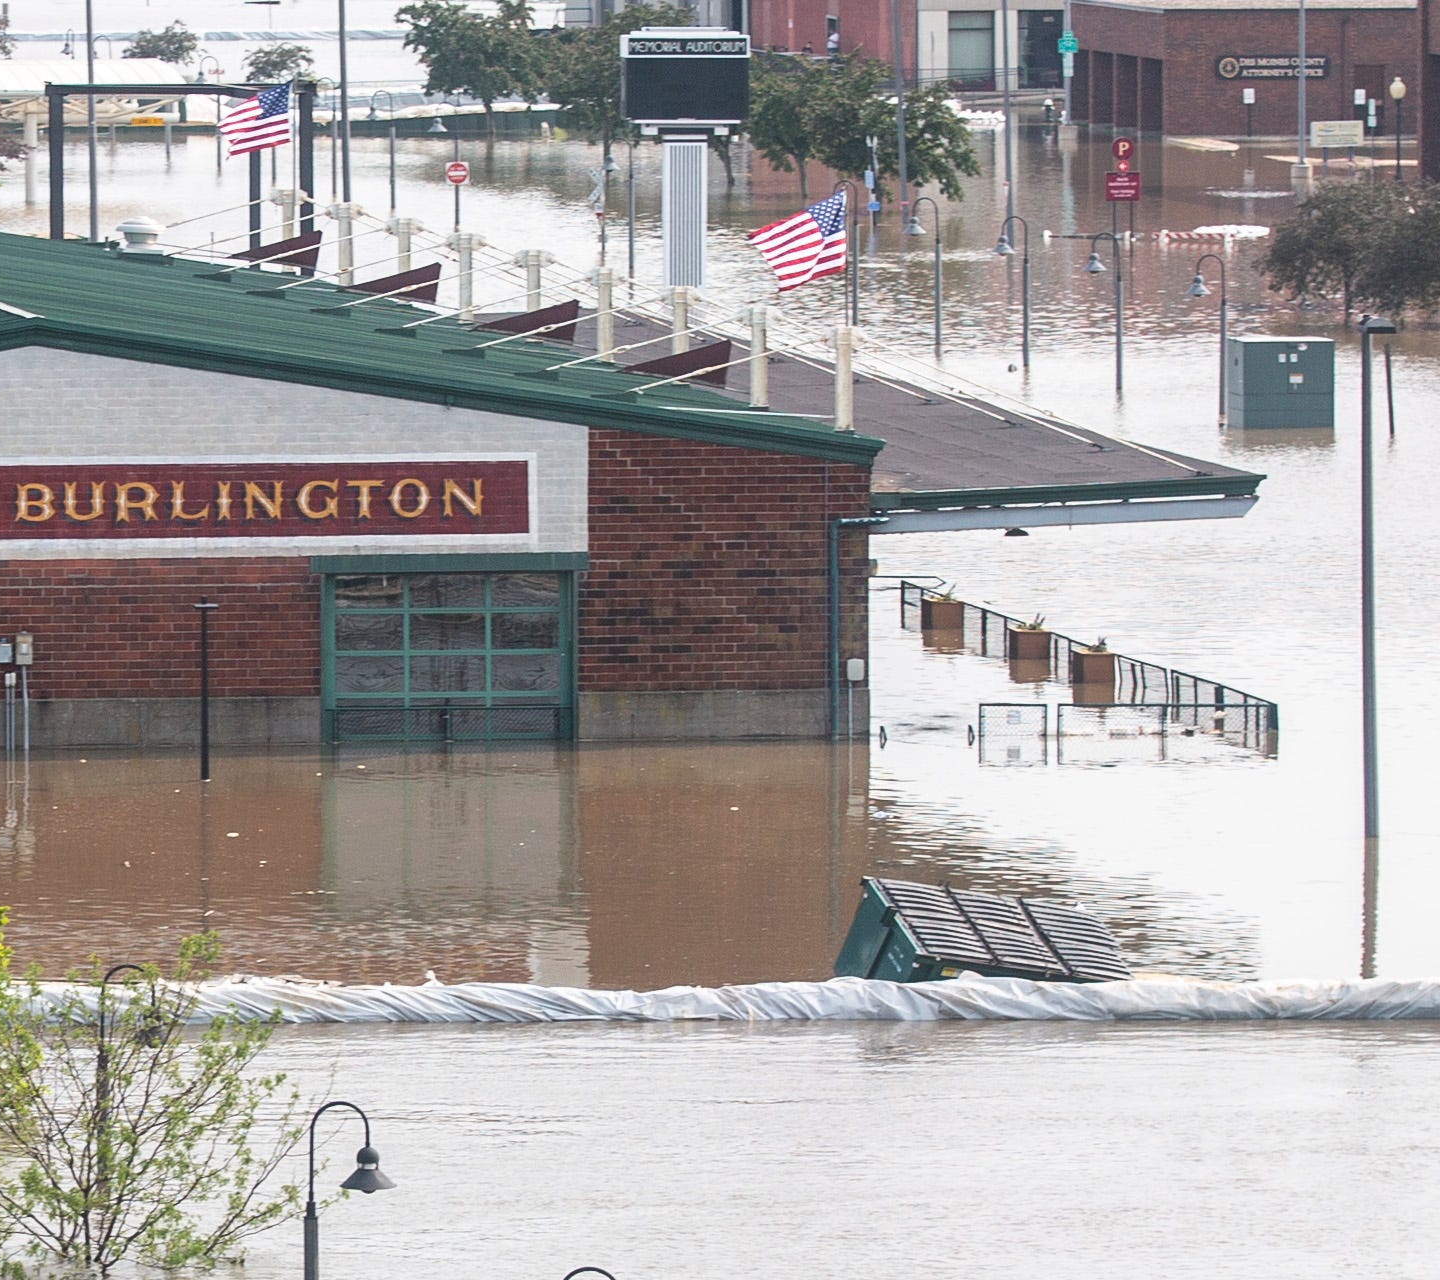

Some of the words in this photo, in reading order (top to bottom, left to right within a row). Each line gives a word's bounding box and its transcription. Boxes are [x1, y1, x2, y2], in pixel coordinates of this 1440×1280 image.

[629, 41, 682, 53] MEMORIAL
[685, 41, 746, 53] AUDITORIUM
[1118, 142, 1130, 156] P
[14, 477, 484, 523] BURLINGTON
